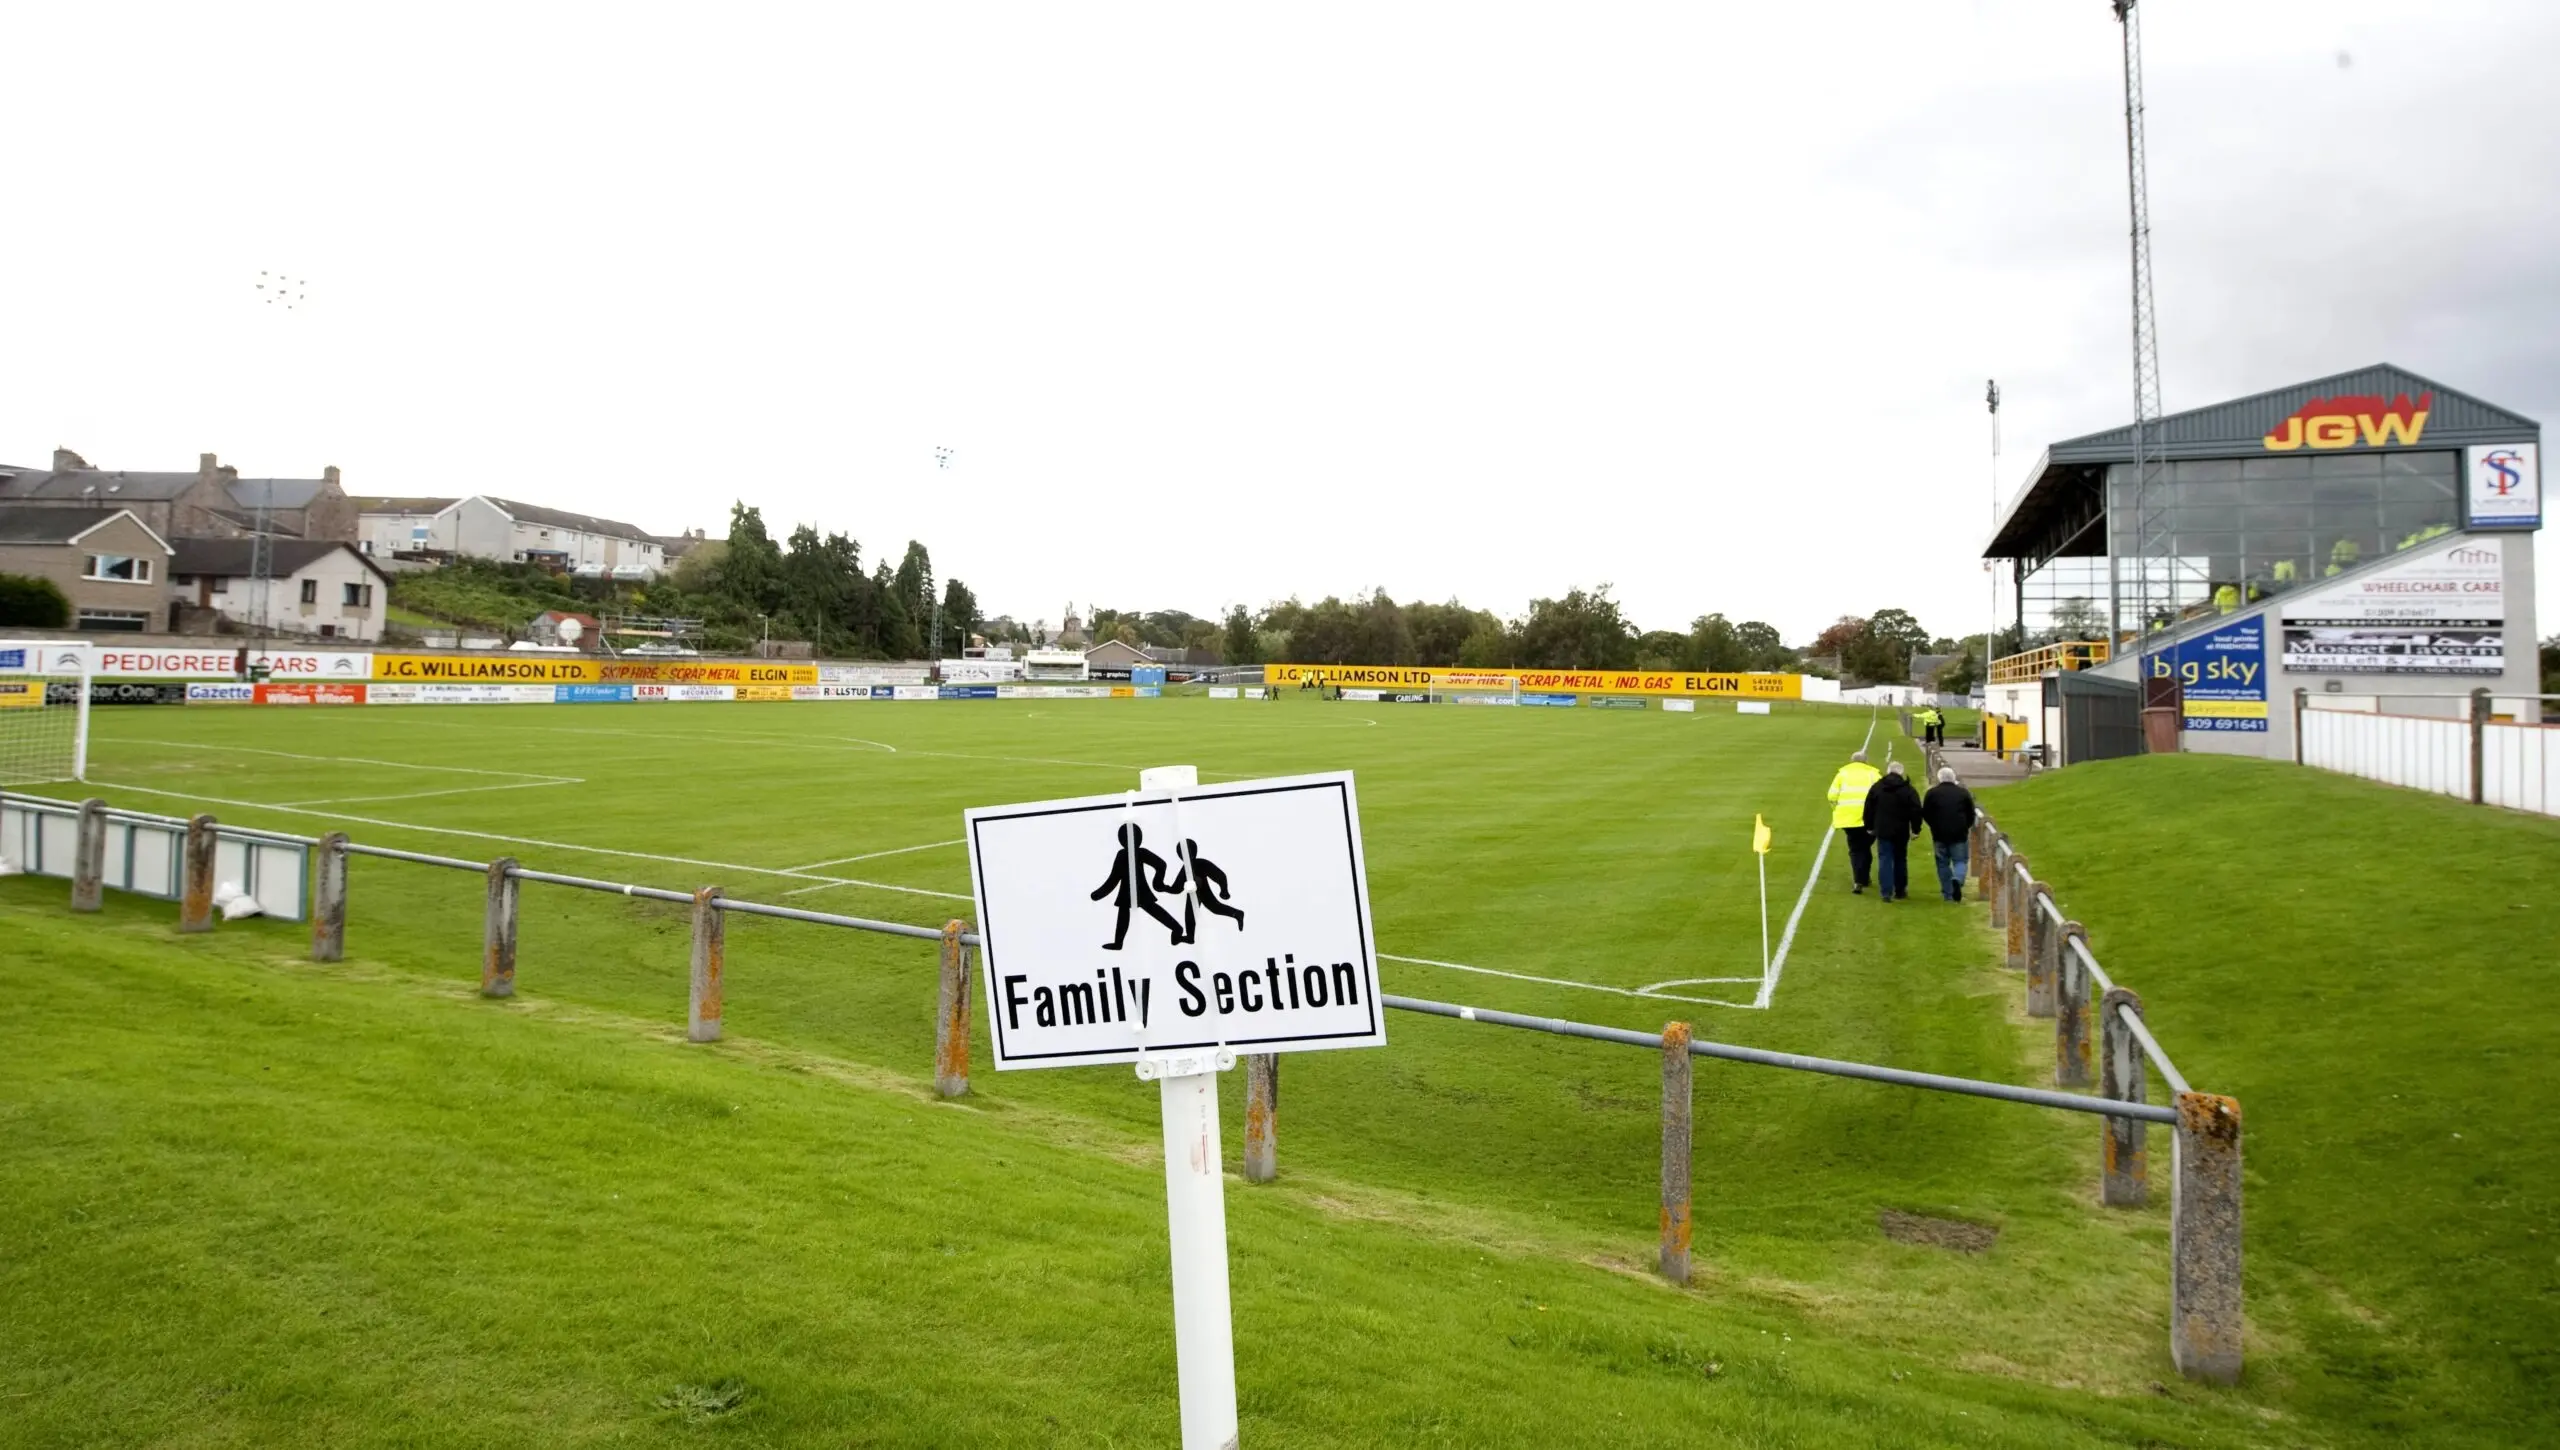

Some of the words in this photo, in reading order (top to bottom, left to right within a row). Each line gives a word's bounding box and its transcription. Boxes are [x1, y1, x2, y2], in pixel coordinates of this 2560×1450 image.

[2263, 411, 2429, 450] JGW
[2363, 582, 2457, 593] WHEELCHAIR
[2463, 582, 2501, 593] CARE
[2289, 640, 2391, 655] Mosset
[2404, 640, 2498, 656] Tavern
[102, 654, 231, 671] PEDIGREE
[383, 662, 417, 676] J.G.
[421, 662, 545, 678] WILLIAMSON
[551, 666, 587, 678] LTD.
[2153, 655, 2199, 685] bg
[2206, 655, 2259, 685] sky
[601, 666, 630, 677] SKIP
[630, 667, 658, 678] HIRE
[669, 669, 706, 682] SCRAP
[707, 671, 741, 681] METAL
[750, 669, 788, 681] ELGIN
[1277, 669, 1300, 680] J.G.
[1404, 672, 1435, 683] LTD.
[1447, 672, 1476, 684] SKIP
[1476, 673, 1507, 686] HIRE
[1518, 674, 1560, 687] SCRAP
[1562, 676, 1604, 688] METAL
[1615, 676, 1641, 689] IND.
[1644, 677, 1673, 690] GAS
[1685, 677, 1739, 691] ELGIN
[48, 684, 116, 697] Chater
[118, 685, 156, 697] One
[190, 686, 251, 699] Gazette
[2187, 719, 2212, 728] 309
[2215, 720, 2265, 729] 691641
[1004, 966, 1151, 1030] Family
[1175, 953, 1359, 1018] Section
